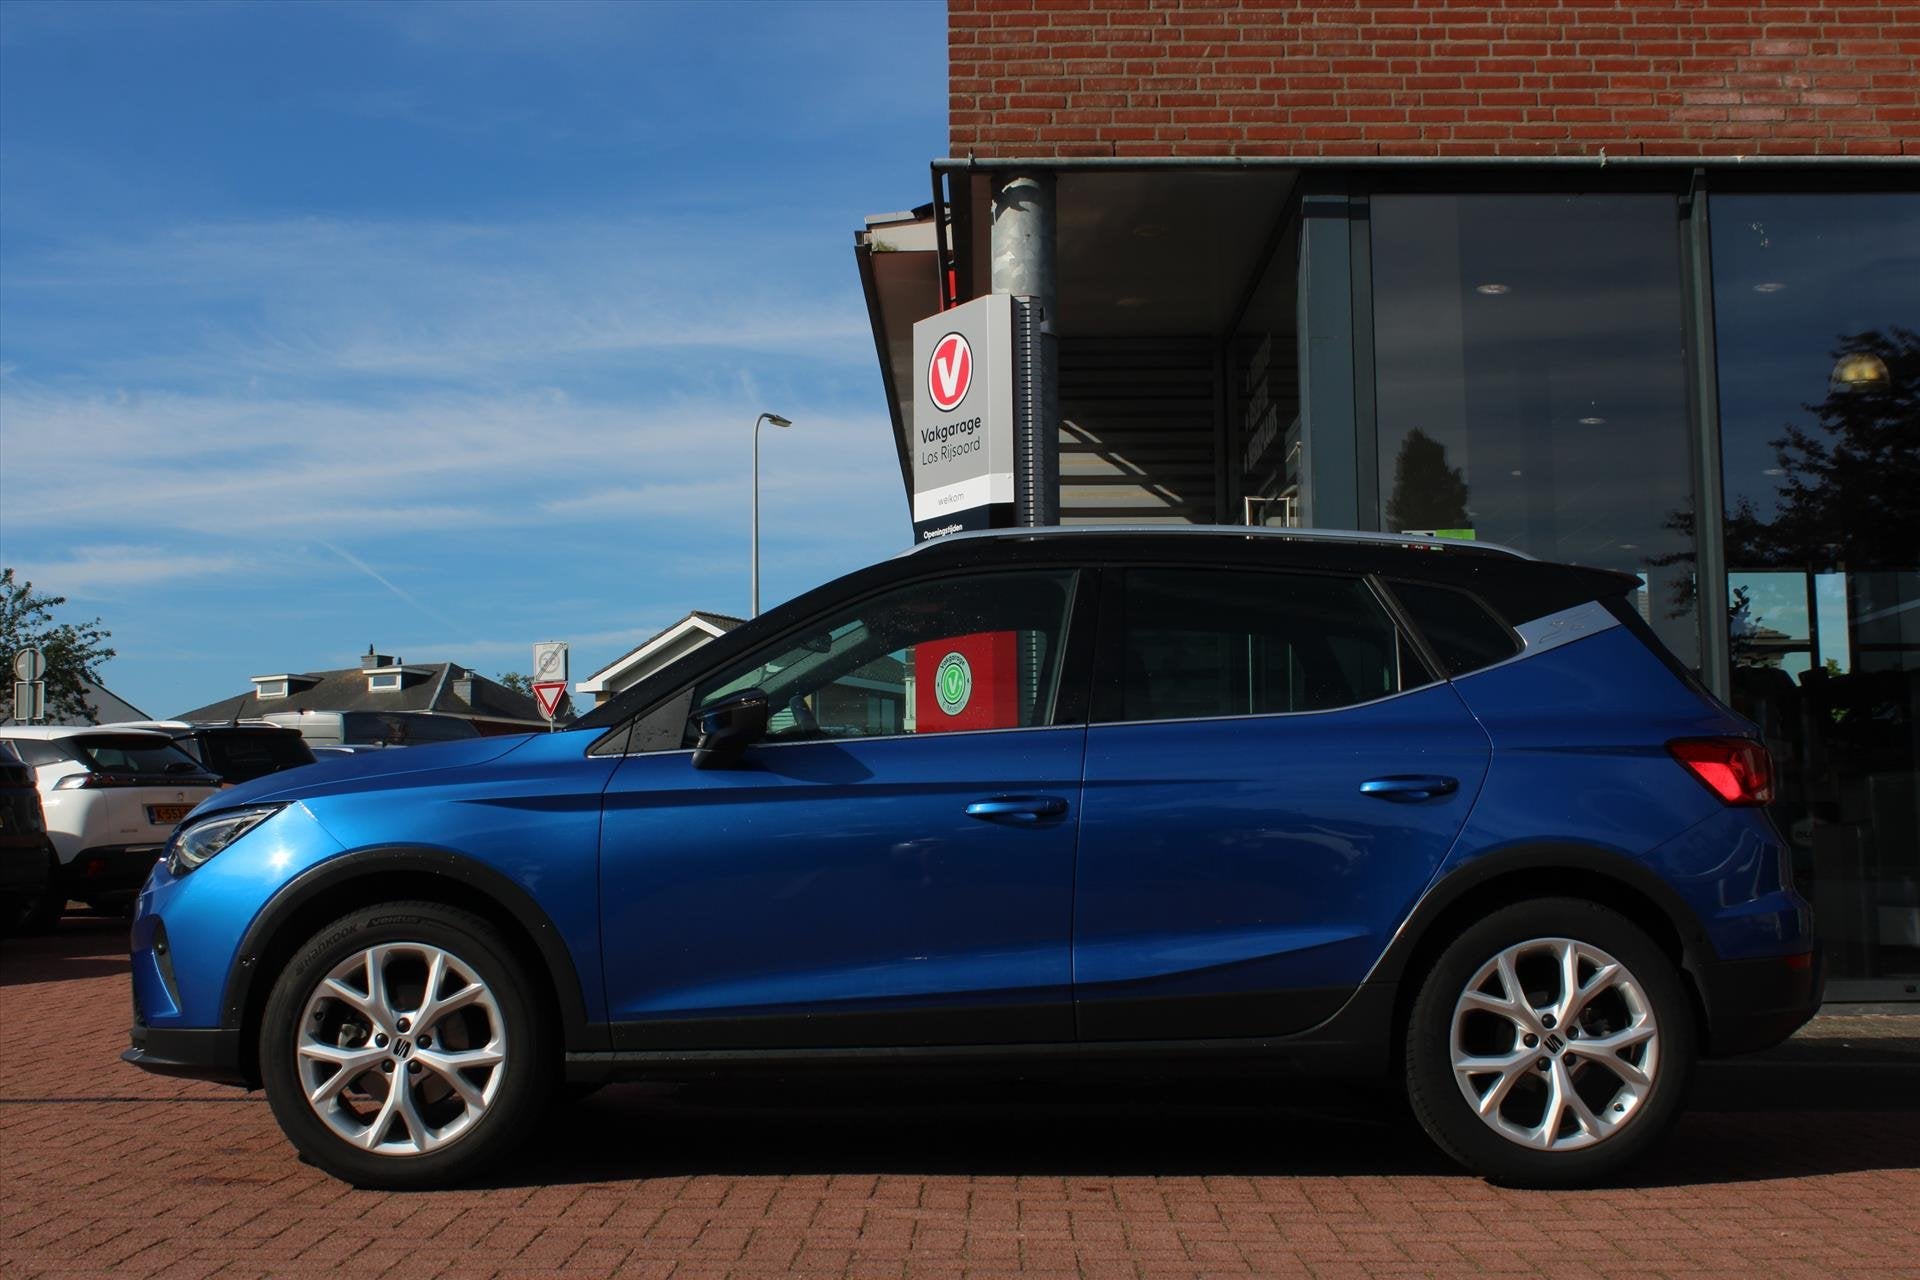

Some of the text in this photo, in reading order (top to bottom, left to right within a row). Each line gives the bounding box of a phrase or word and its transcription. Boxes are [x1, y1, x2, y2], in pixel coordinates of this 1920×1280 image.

[921, 416, 982, 444] Vakgarage
[922, 436, 981, 466] Los Rijsoord
[938, 491, 965, 506] welkom
[923, 523, 964, 540] Openingstijden
